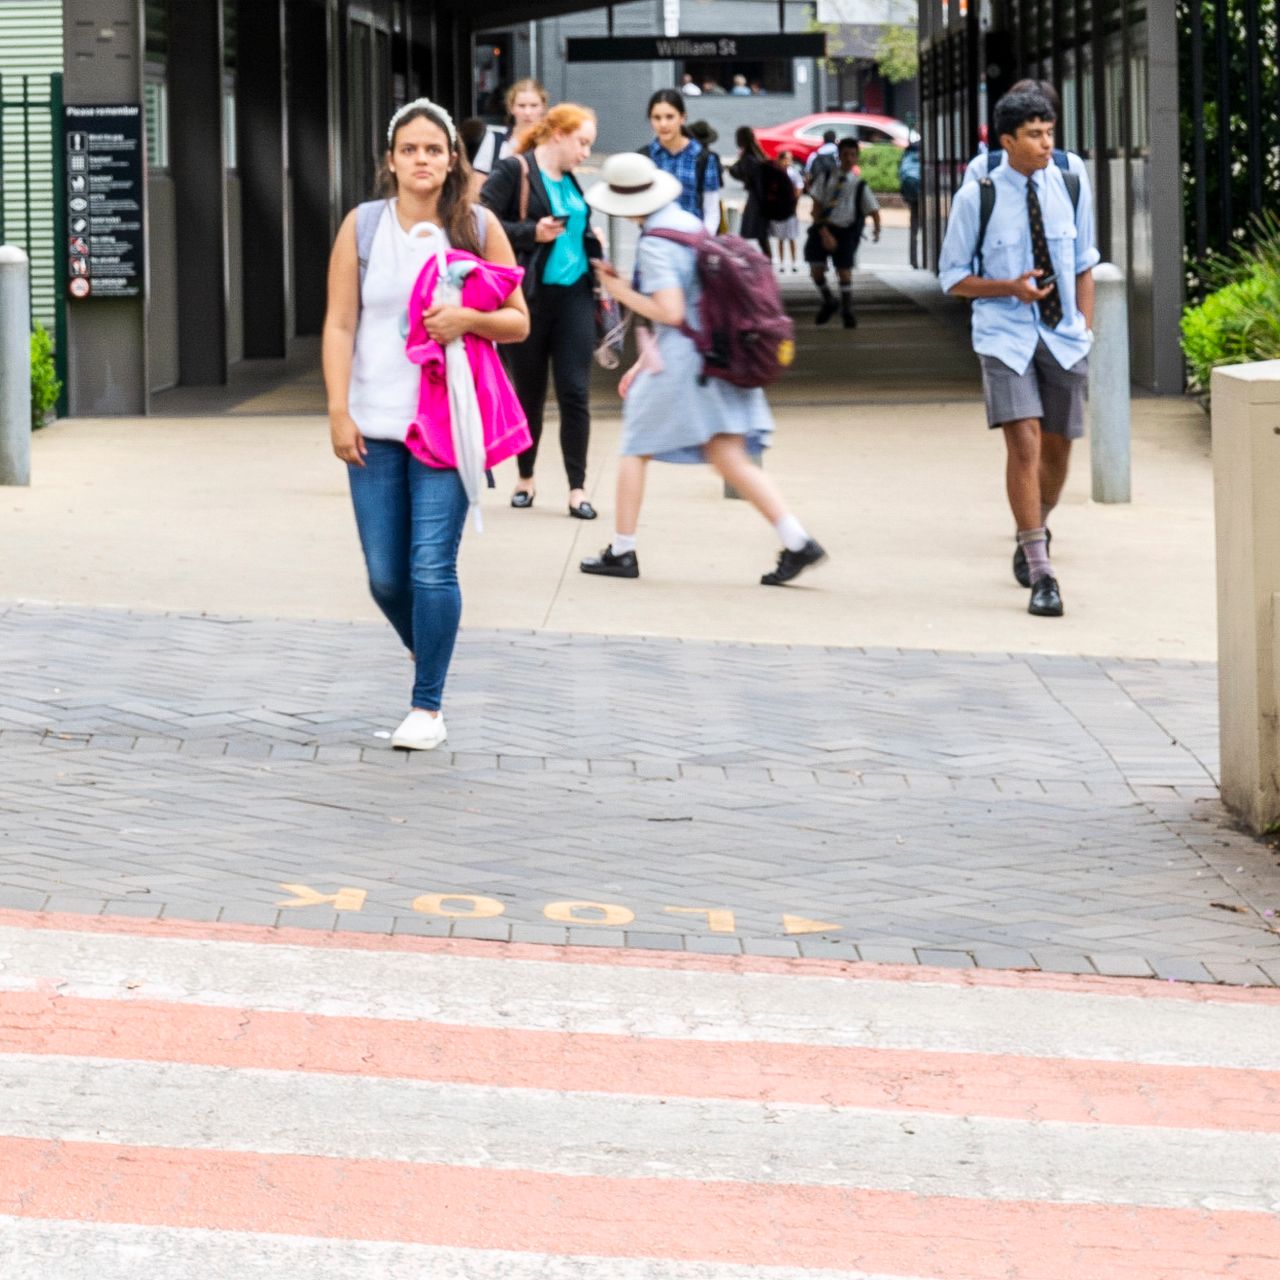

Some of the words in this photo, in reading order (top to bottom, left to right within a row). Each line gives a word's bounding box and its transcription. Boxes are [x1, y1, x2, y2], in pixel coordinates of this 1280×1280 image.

[656, 39, 717, 56] William
[718, 38, 737, 56] St
[66, 106, 94, 117] Please
[95, 106, 139, 116] remember
[273, 883, 735, 933] LOOK
